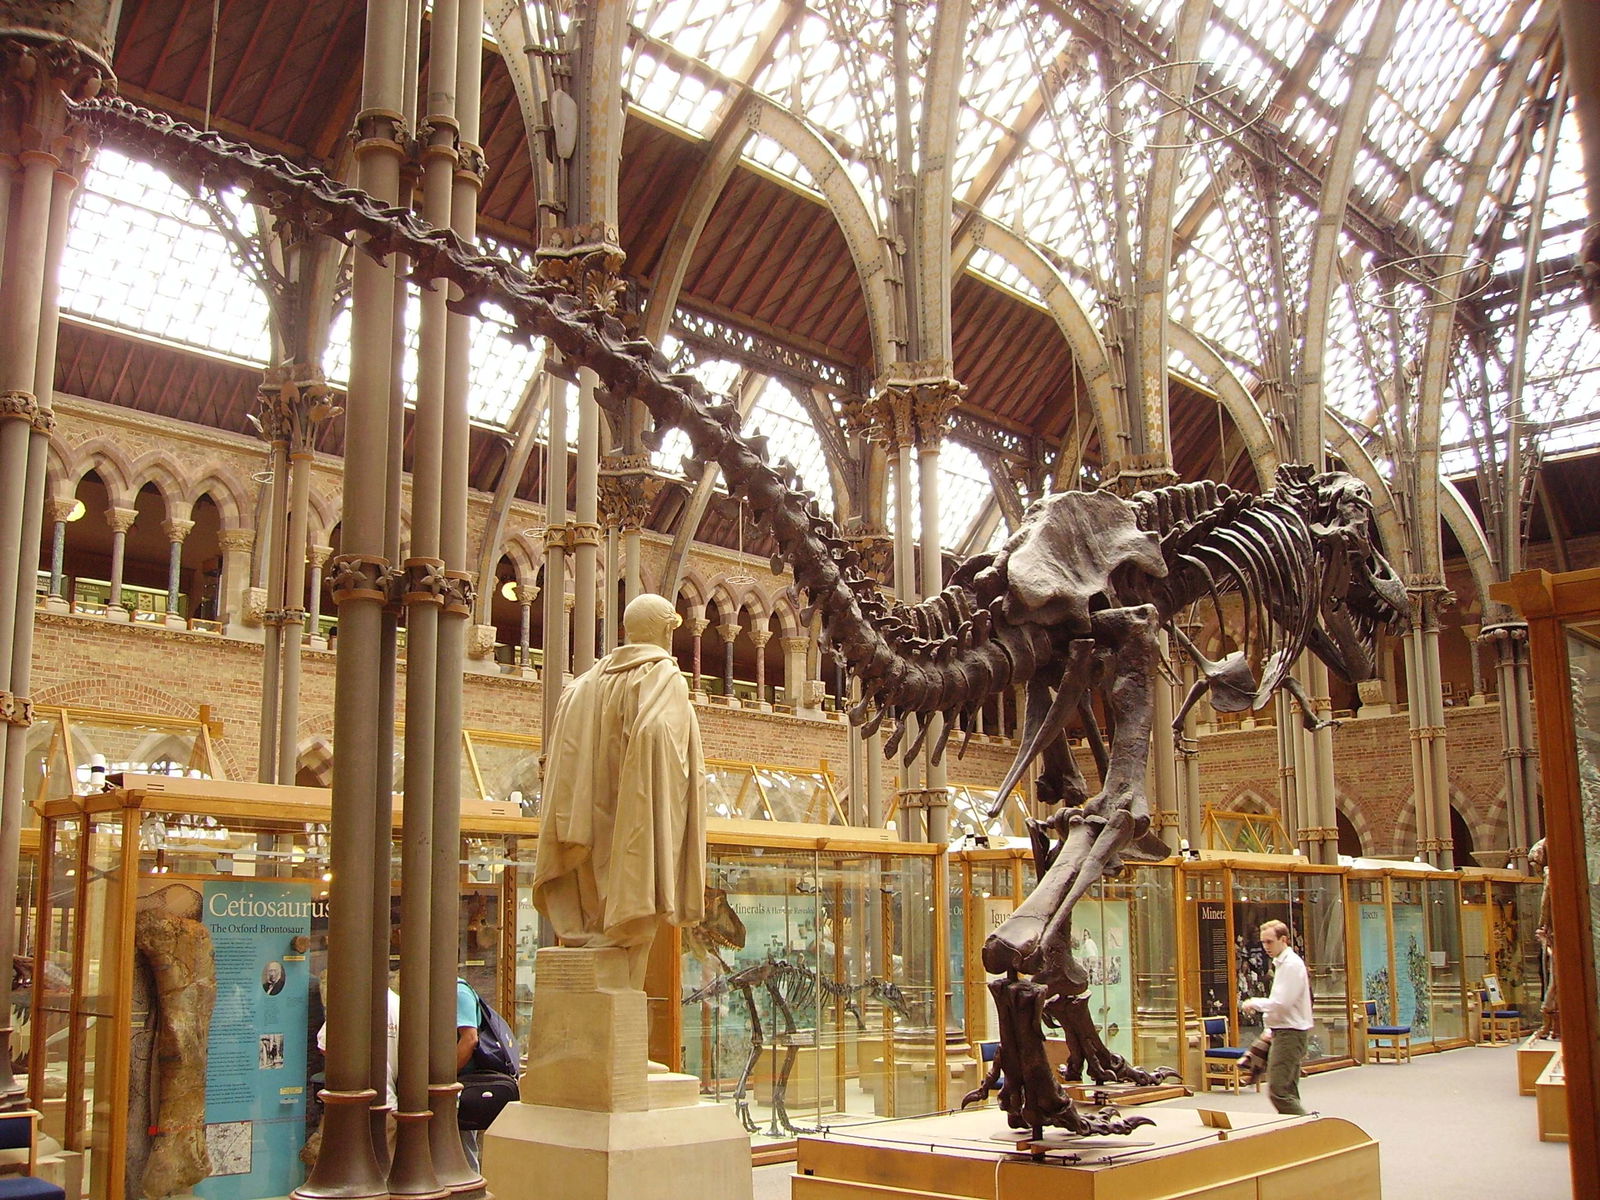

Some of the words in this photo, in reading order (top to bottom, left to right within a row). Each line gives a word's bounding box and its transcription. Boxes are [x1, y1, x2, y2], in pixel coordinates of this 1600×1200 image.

[211, 924, 227, 933] The
[228, 924, 258, 933] Oxford
[260, 924, 304, 934] Brontosaur
